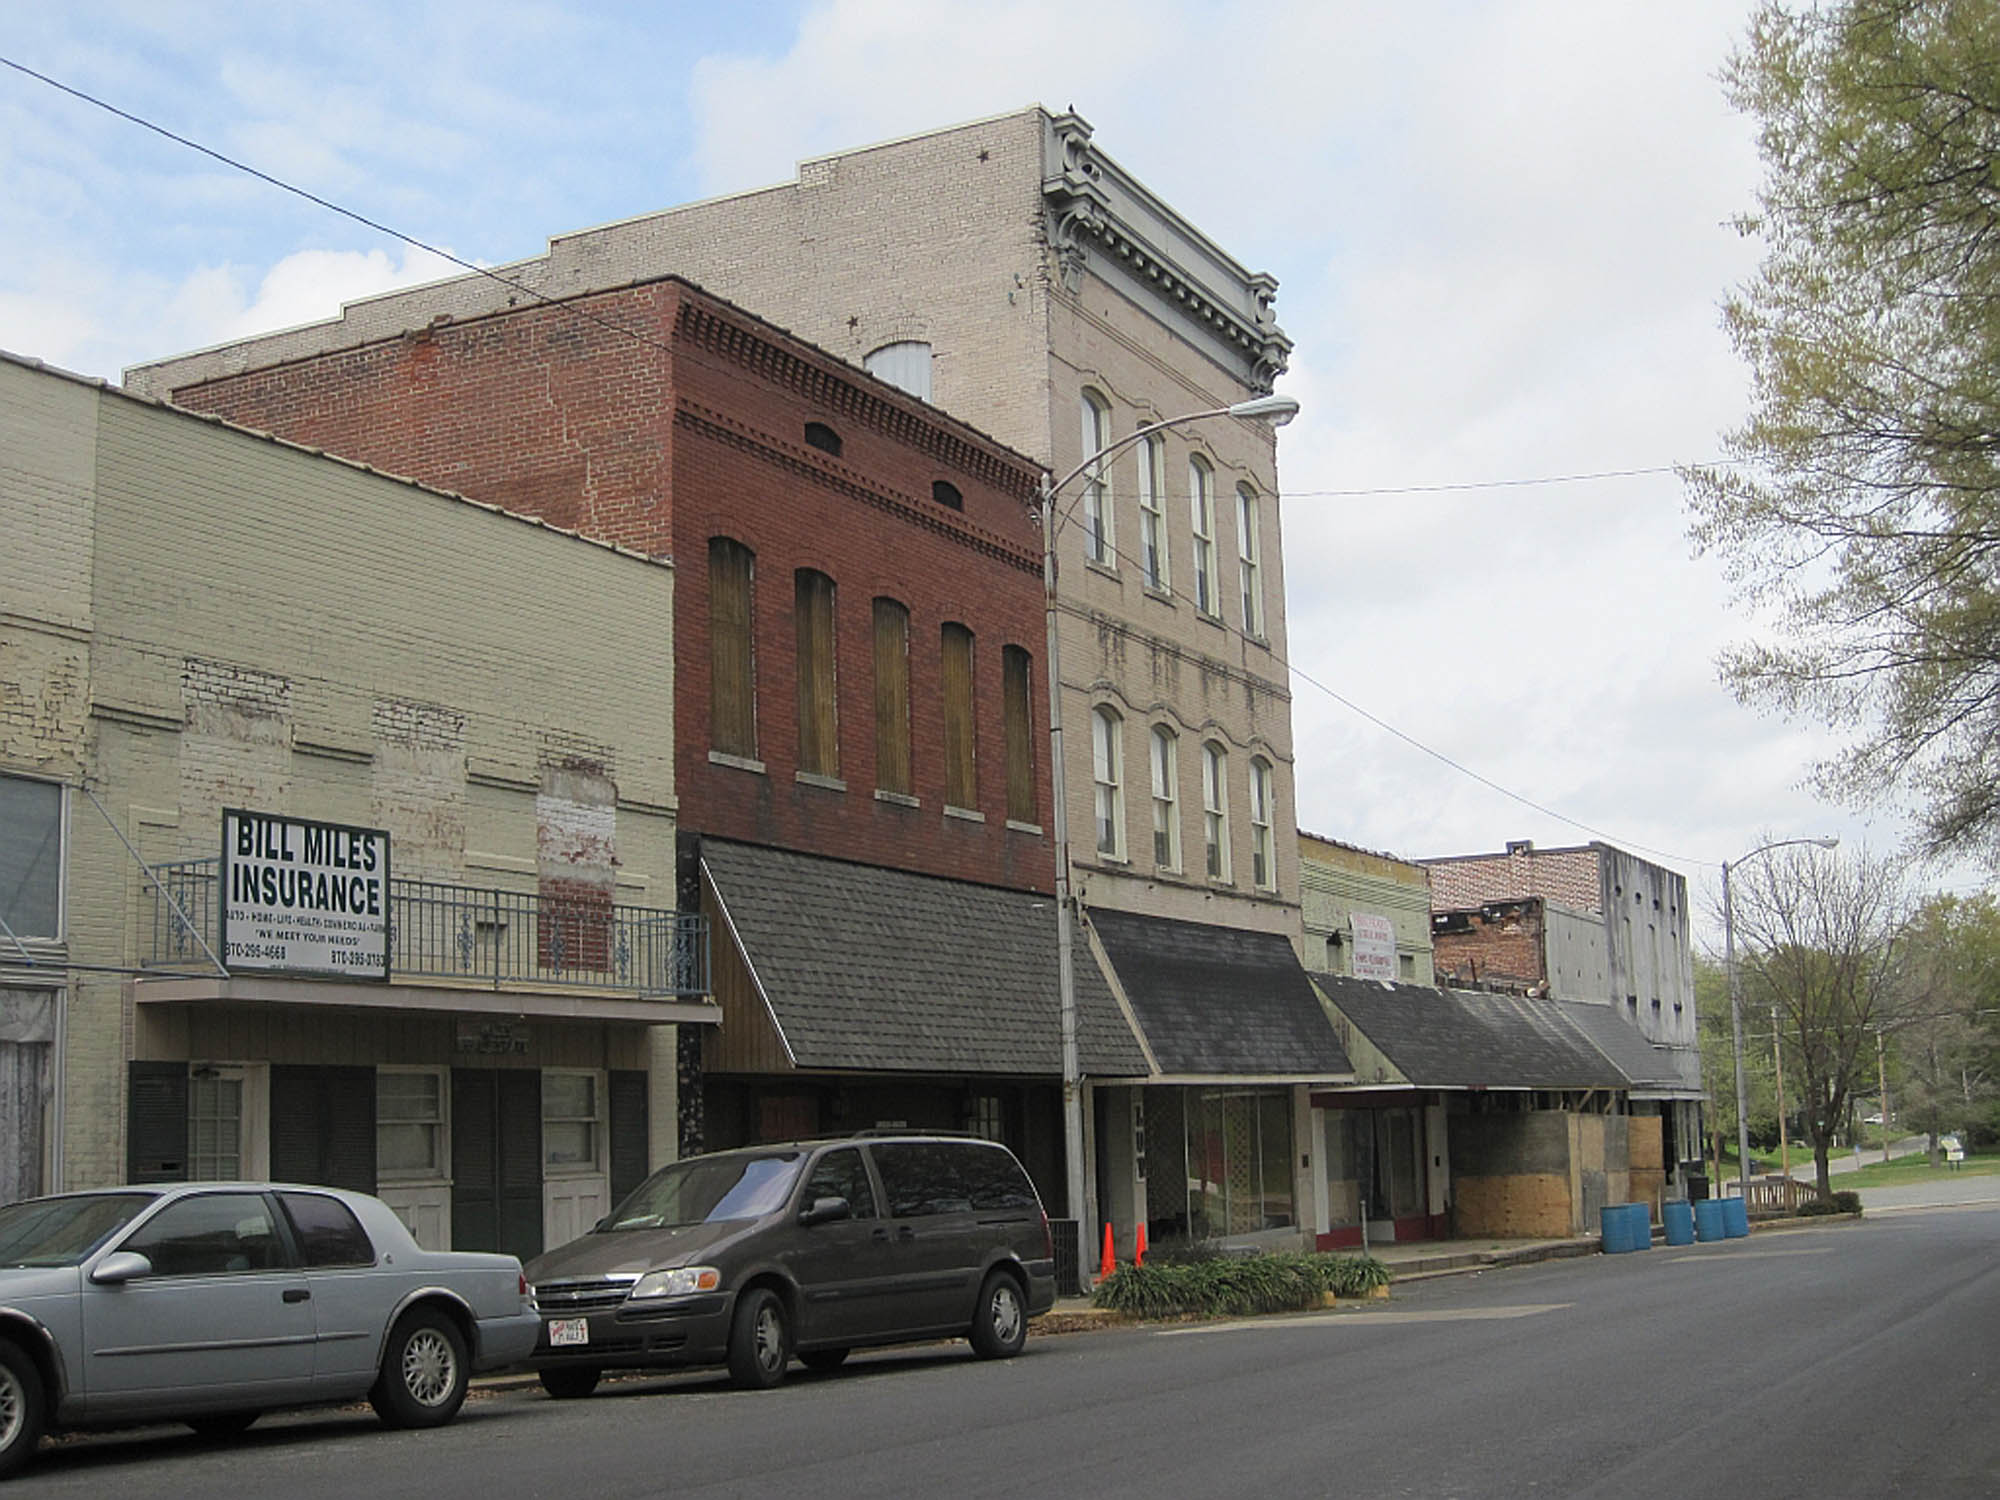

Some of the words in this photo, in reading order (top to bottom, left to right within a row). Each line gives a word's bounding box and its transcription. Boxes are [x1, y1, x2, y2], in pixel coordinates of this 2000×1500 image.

[238, 815, 293, 861] BILL
[304, 825, 376, 872] MILES
[233, 863, 380, 915] INSURANCE
[276, 930, 300, 942] MEET
